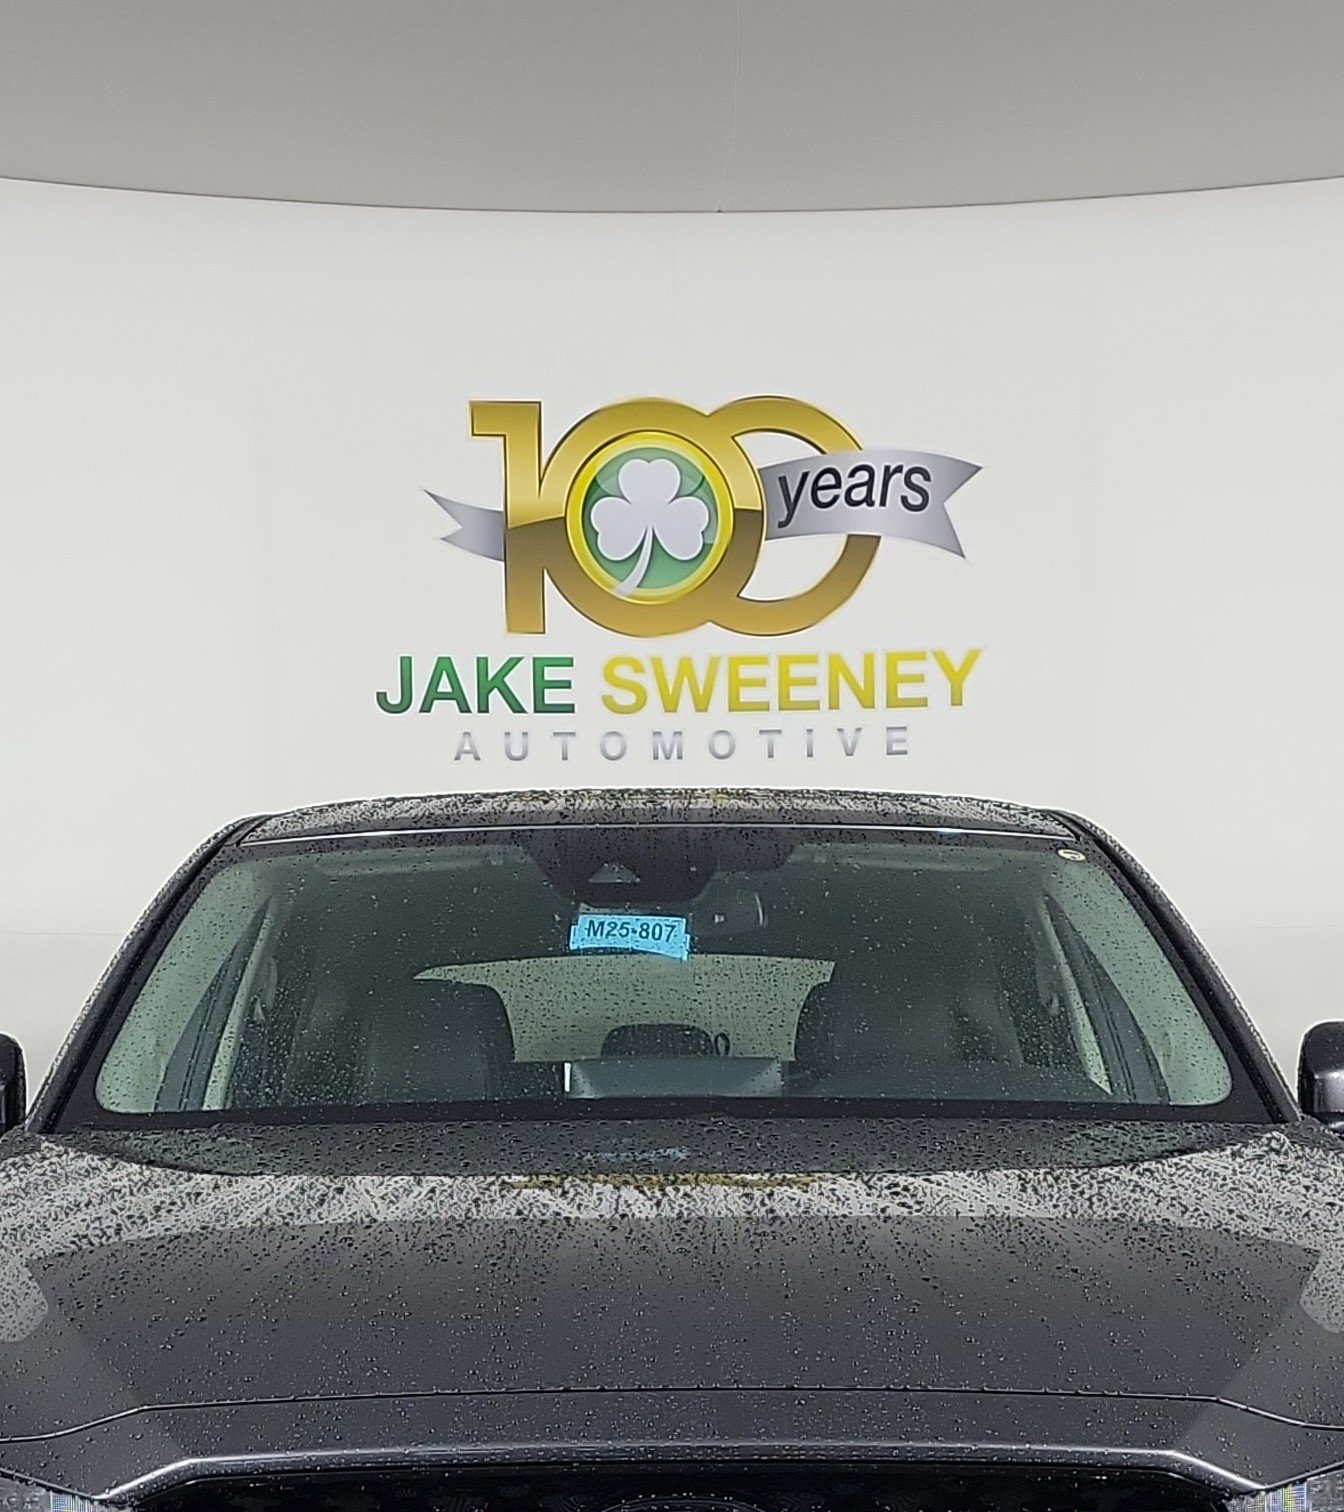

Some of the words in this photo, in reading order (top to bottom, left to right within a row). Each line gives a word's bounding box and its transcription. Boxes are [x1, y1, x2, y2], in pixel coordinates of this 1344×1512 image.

[465, 396, 882, 636] 100
[774, 462, 935, 528] years
[375, 655, 576, 715] JAKE
[601, 649, 983, 715] SWEENEY
[453, 725, 911, 762] AUTOMOTIVE
[586, 919, 676, 943] M25-807
